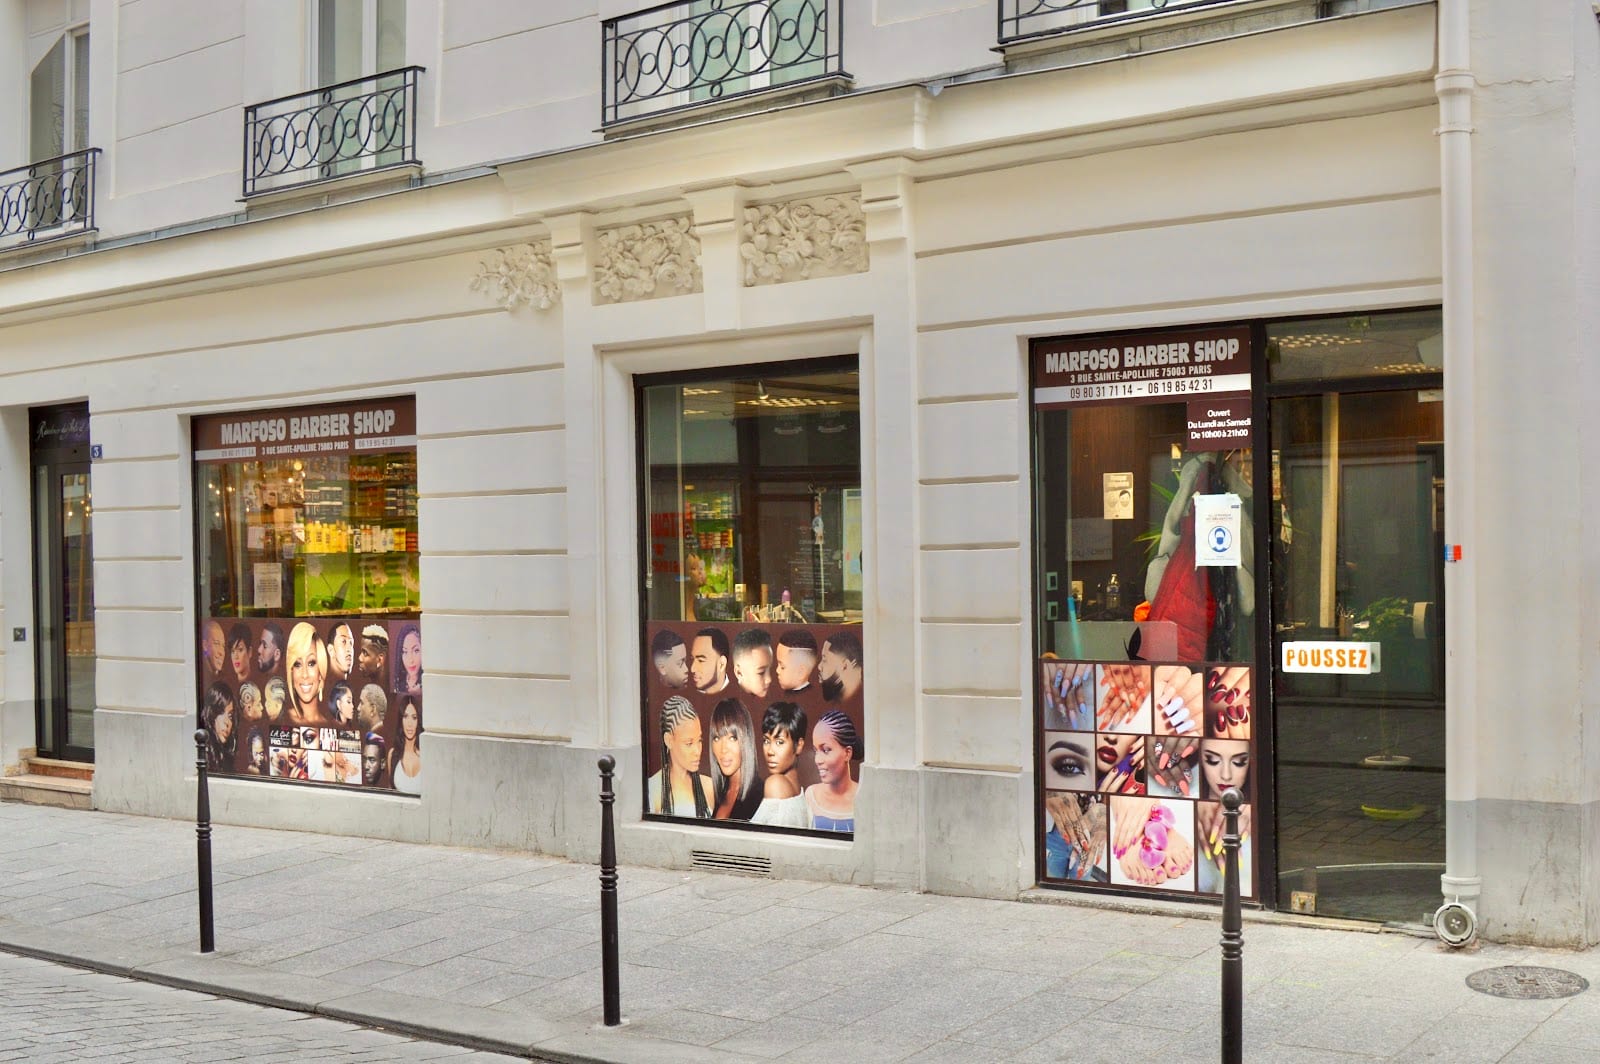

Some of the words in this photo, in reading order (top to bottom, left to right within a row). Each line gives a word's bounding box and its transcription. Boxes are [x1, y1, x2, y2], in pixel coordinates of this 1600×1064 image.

[1046, 348, 1119, 373] MARFOSO
[1124, 343, 1190, 368] BARBER
[1194, 339, 1239, 362] SHOP
[1070, 374, 1076, 383] 3
[1077, 372, 1093, 383] RUE
[1094, 368, 1160, 383] SAINTE-APOLLINE
[1161, 366, 1186, 377] 75003
[1188, 364, 1212, 375] PARIS
[1070, 388, 1081, 399] 09
[1083, 387, 1093, 398] 80
[1096, 386, 1105, 398] 31
[1109, 385, 1118, 396] 71
[1123, 384, 1133, 396] 14
[1148, 382, 1159, 394] 06
[1162, 381, 1172, 393] 19
[1175, 381, 1186, 392] 85
[1188, 380, 1200, 391] 42
[1202, 379, 1213, 390] 31
[1207, 409, 1231, 417] Ouvert
[222, 419, 286, 444] MARFOSO
[291, 414, 350, 439] BARBER
[354, 410, 395, 434] SHOP
[1188, 421, 1197, 429] Du
[1198, 420, 1216, 428] Lundi
[1226, 417, 1251, 427] Samedi
[1191, 431, 1201, 439] De
[1227, 429, 1248, 437] 21h00
[1286, 648, 1367, 668] POUSSEZ
